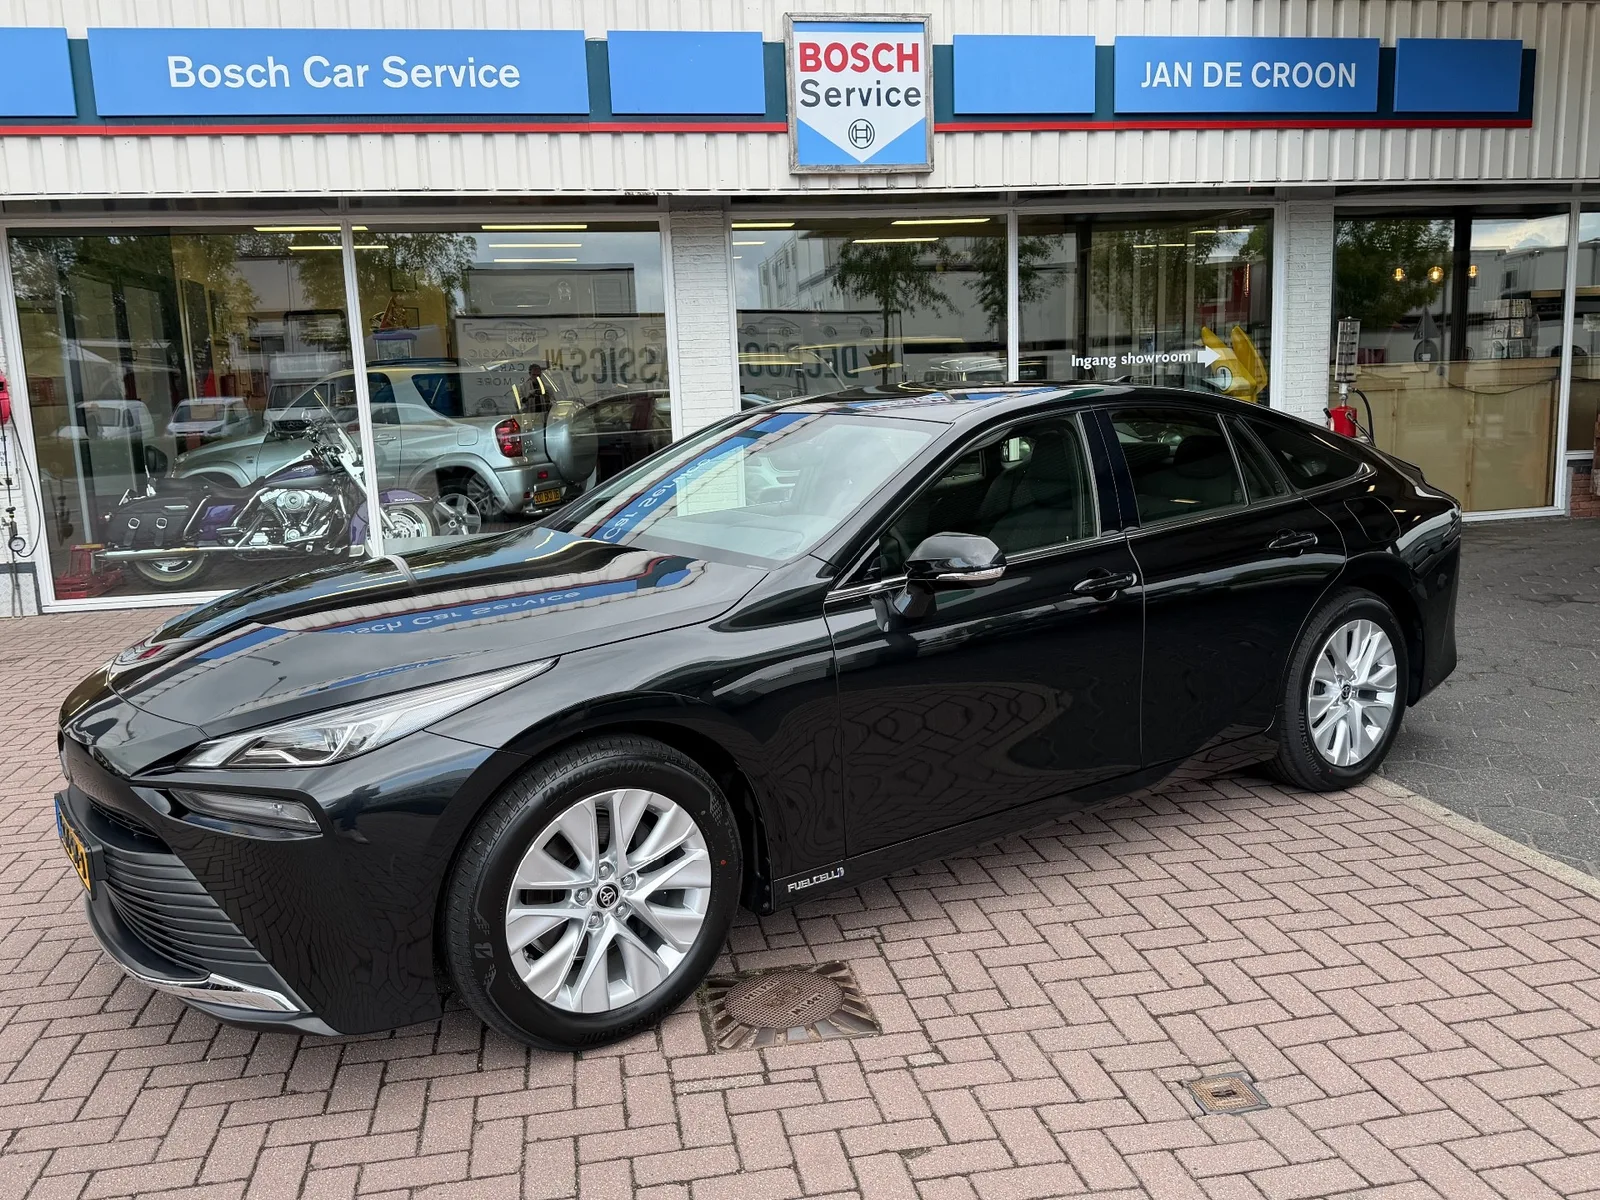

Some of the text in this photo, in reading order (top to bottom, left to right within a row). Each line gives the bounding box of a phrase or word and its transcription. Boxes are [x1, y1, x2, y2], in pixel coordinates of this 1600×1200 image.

[167, 55, 521, 88] Bosch Car Service
[799, 42, 920, 73] BOSCH
[1141, 61, 1356, 88] JAN DE CROON
[800, 79, 922, 108] Service
[1071, 351, 1191, 370] Ingang showroom
